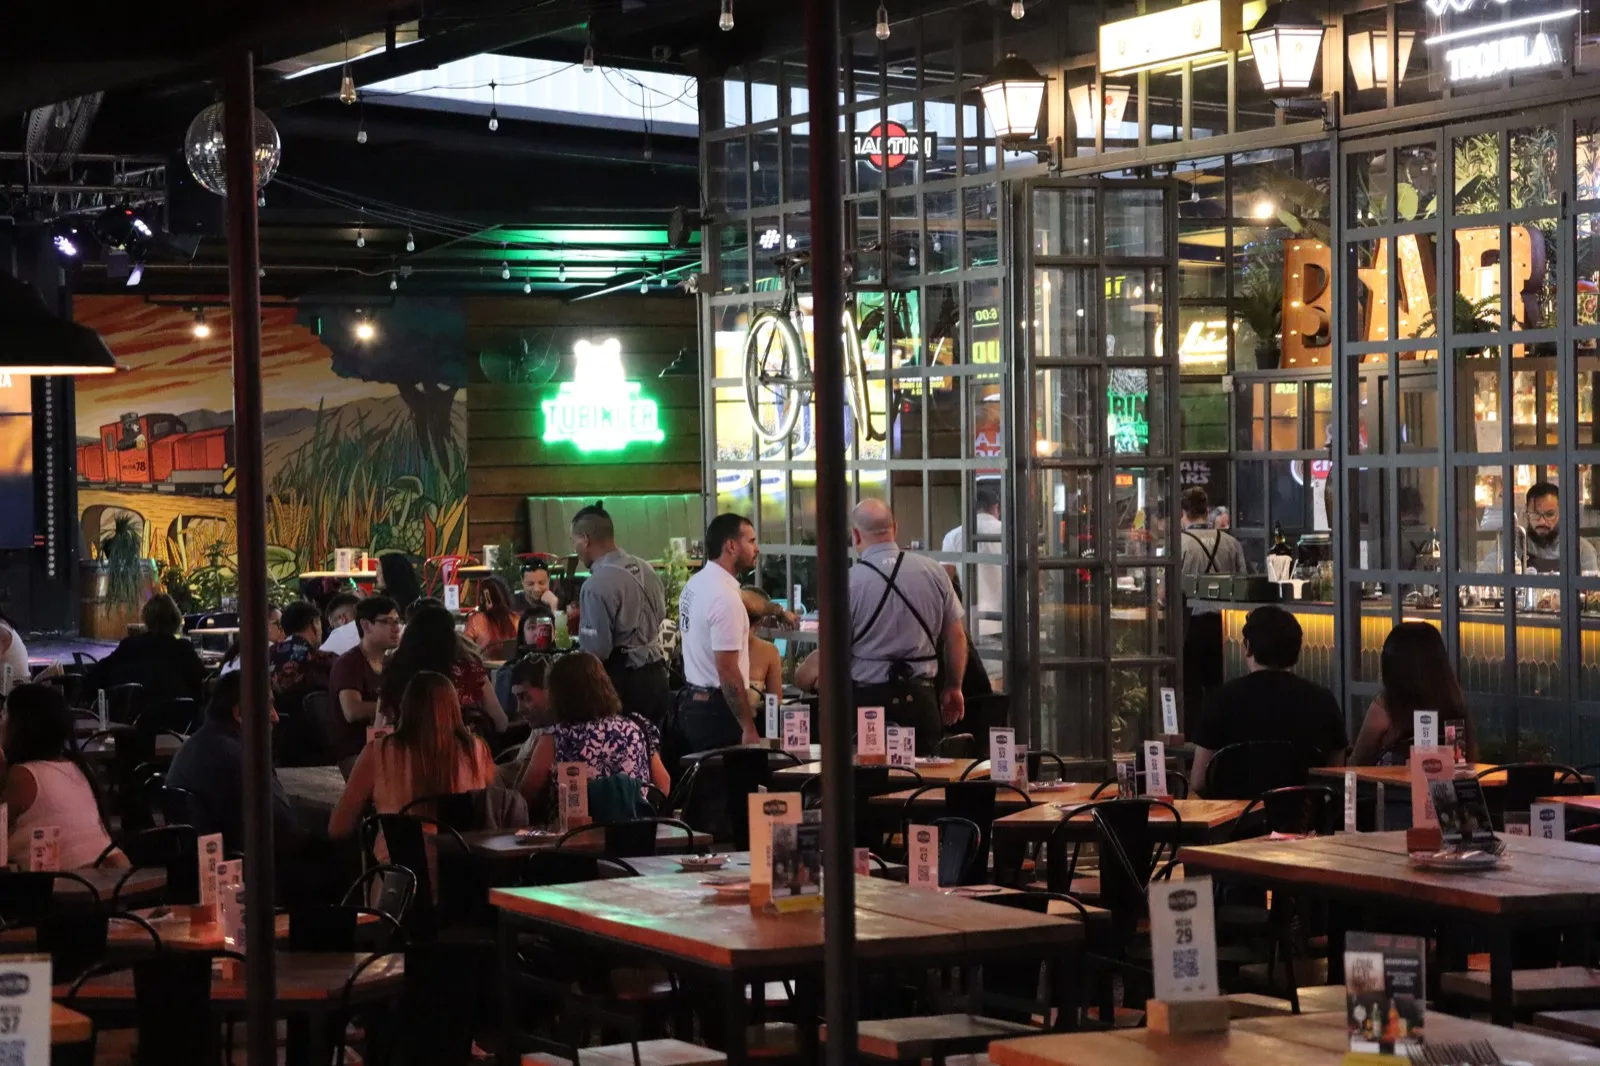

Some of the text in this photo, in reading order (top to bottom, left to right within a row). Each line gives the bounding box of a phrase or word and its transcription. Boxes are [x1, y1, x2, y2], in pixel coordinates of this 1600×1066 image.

[1282, 226, 1533, 368] BAR
[543, 402, 656, 432] TUBINER
[1180, 461, 1211, 471] AR
[1175, 928, 1193, 944] 29
[0, 1016, 20, 1034] 37
